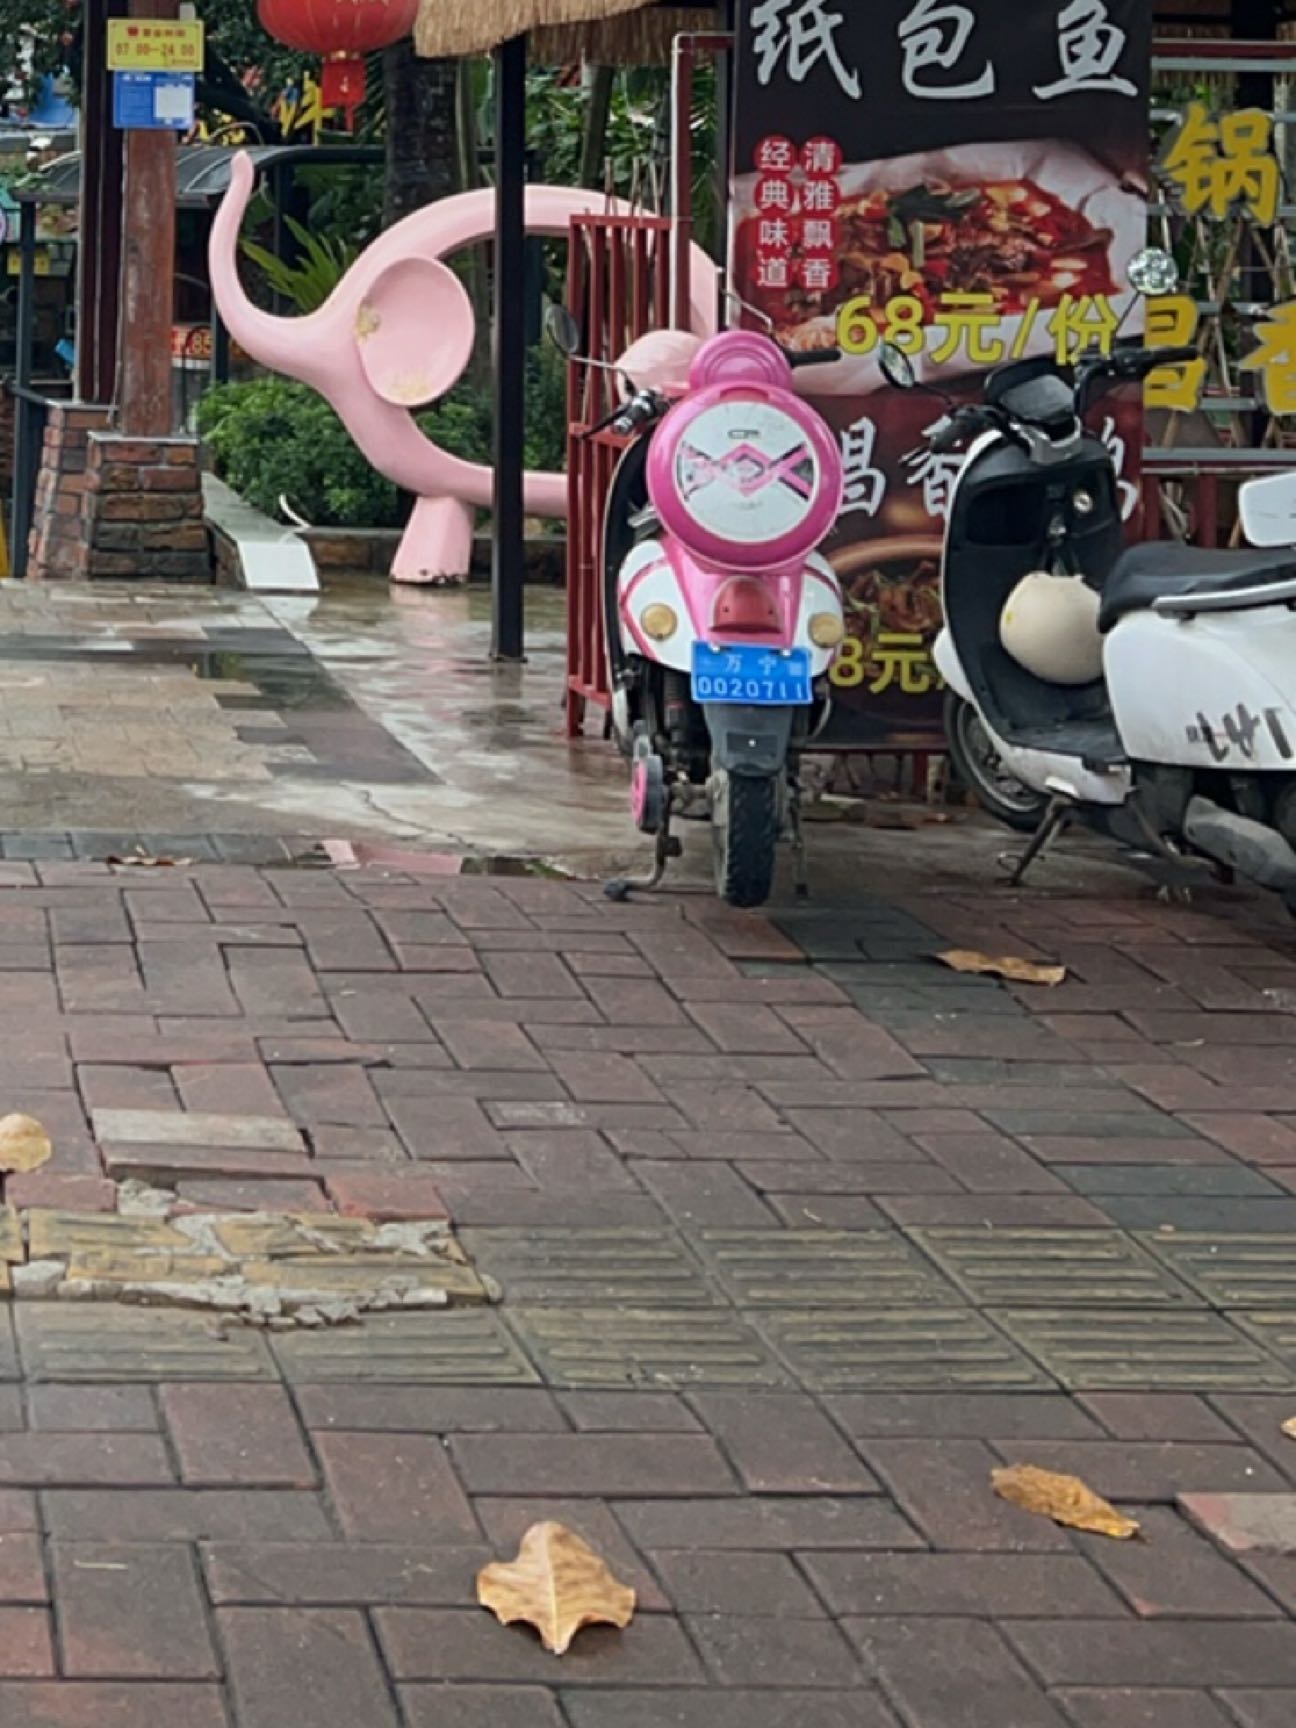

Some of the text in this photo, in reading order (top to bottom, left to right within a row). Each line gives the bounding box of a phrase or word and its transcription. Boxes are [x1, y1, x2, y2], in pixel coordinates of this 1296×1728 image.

[758, 141, 793, 288] 经典味道
[801, 141, 836, 289] 清雅飘香
[836, 292, 1120, 368] 68元/份
[697, 676, 803, 699] 0020711
[828, 633, 944, 693] 8元
